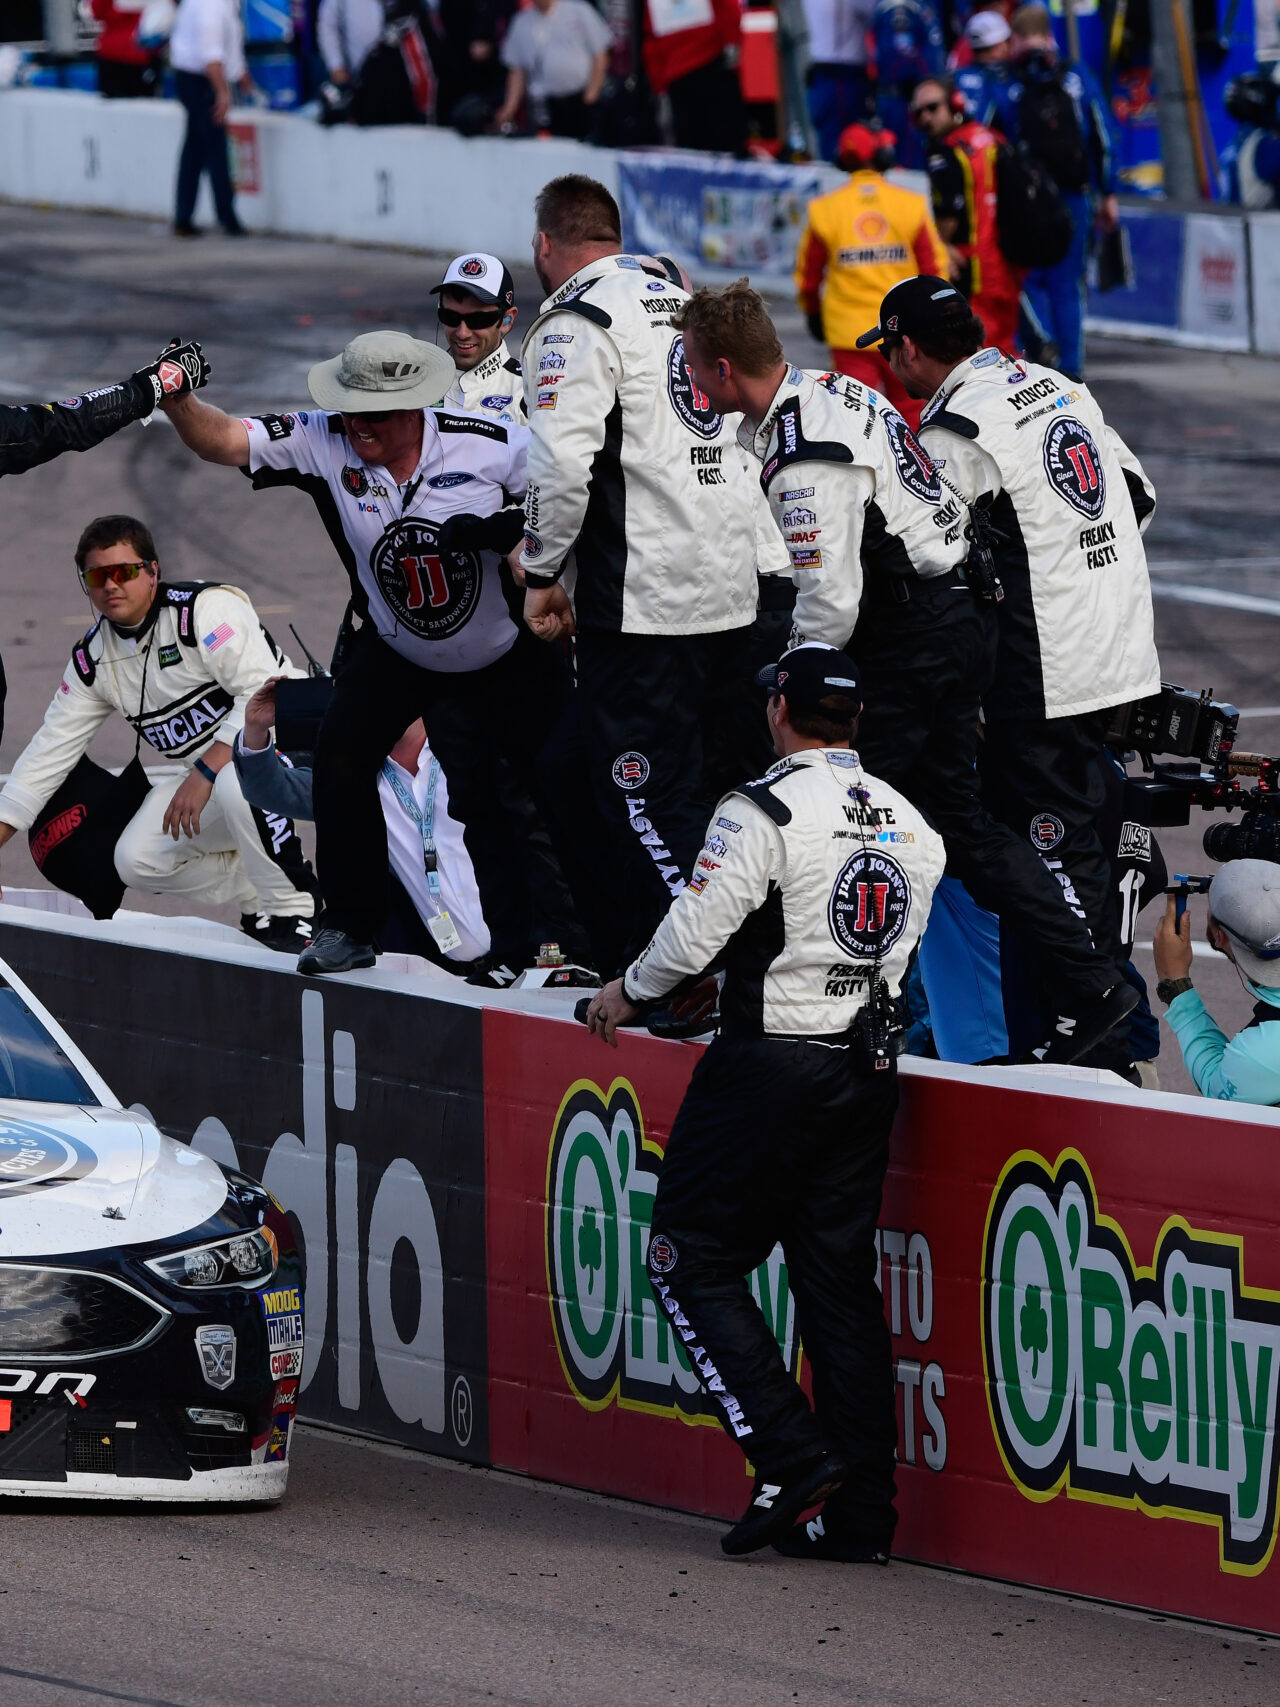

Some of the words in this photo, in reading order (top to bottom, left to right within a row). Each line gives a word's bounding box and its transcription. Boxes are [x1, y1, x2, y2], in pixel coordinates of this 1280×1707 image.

[887, 315, 899, 331] 4
[474, 352, 502, 377] FREAKY
[1007, 378, 1060, 411] MINCEY
[270, 421, 285, 437] TD1
[444, 419, 474, 428] FREAKY
[475, 422, 495, 433] FAST!
[691, 446, 724, 466] FREAKY
[1051, 426, 1067, 470] JIMMY
[1056, 471, 1074, 482] Since
[785, 488, 815, 500] NASCAR
[782, 512, 817, 528] BUSCH
[1079, 521, 1116, 550] FREAKY
[1087, 544, 1119, 570] FAST!
[428, 580, 472, 628] SANDWICHES
[143, 698, 228, 750] FFICIAL
[1168, 715, 1182, 741] ARRI
[836, 901, 854, 911] Since
[836, 912, 865, 952] GOURMET
[263, 1288, 301, 1316] MOOG
[268, 1314, 302, 1346] MAHLE
[999, 1203, 1276, 1519] O'Reilly
[687, 1345, 754, 1438] FREAKY
[893, 1357, 948, 1472] TS
